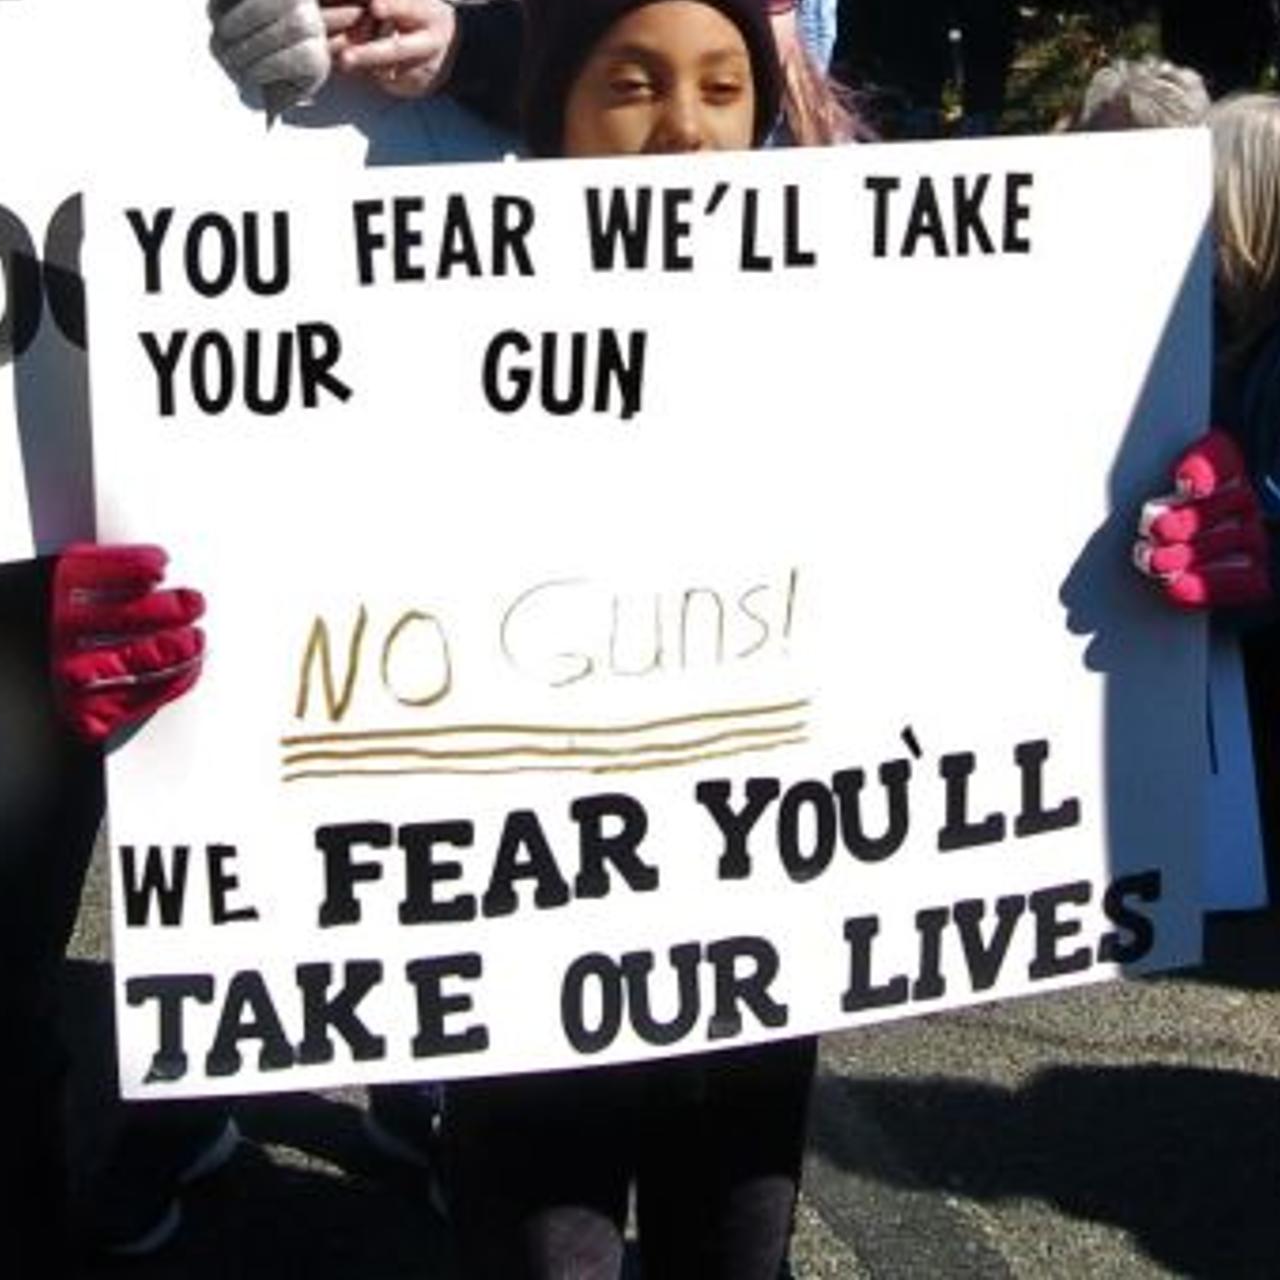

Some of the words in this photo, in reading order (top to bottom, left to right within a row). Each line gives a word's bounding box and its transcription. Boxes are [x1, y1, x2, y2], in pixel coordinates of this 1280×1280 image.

[125, 208, 290, 298] YOU
[353, 194, 535, 287] FEAR
[586, 183, 817, 273] WE'LL
[865, 173, 1034, 258] TAKE
[139, 322, 353, 417] YOUR
[482, 328, 647, 420] GUN
[295, 605, 453, 723] NO
[120, 844, 259, 926] WE
[315, 794, 659, 928] FEAR
[696, 724, 1081, 883] YOU'LL
[126, 953, 490, 1084] TAKE
[561, 936, 789, 1055] OUR
[841, 870, 1164, 1012] LIVES
